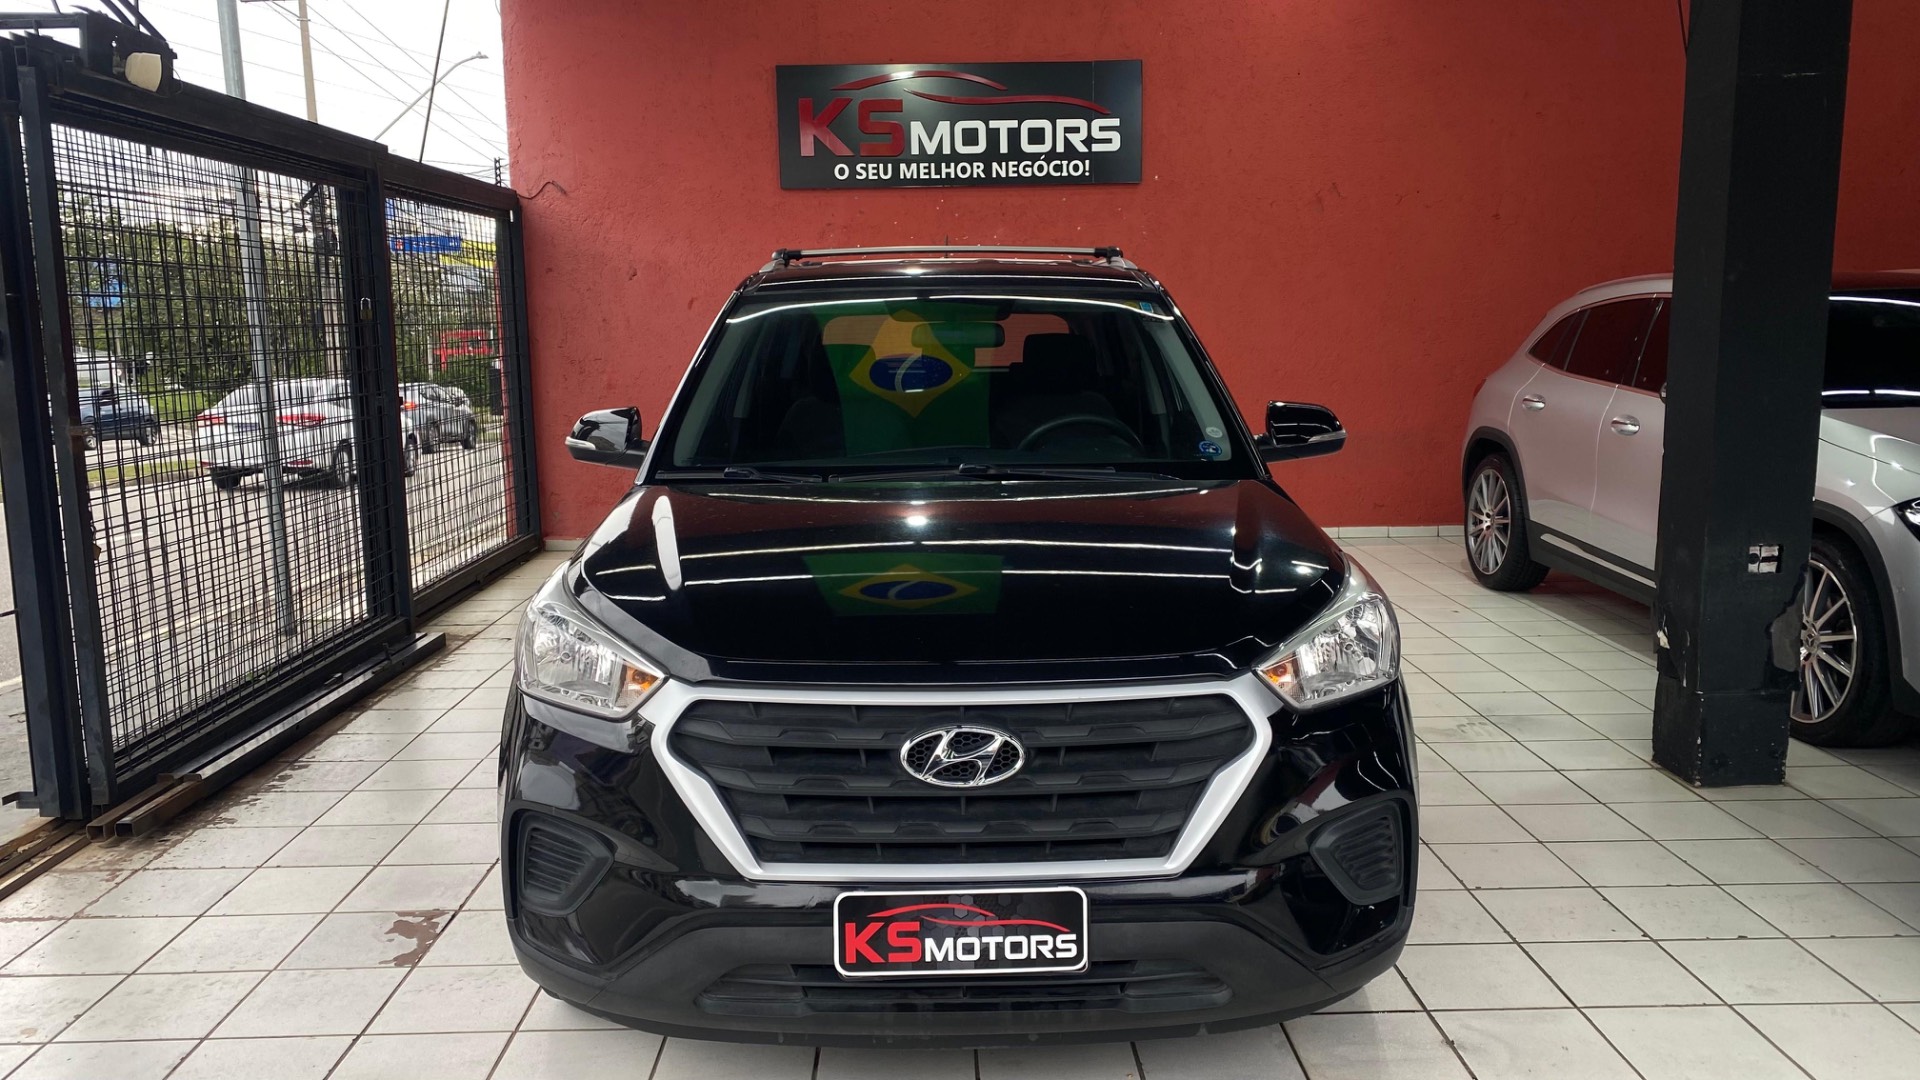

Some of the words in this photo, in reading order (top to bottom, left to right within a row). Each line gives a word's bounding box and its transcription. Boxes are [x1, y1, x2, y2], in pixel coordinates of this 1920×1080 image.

[798, 97, 905, 157] KS
[909, 118, 1121, 155] MOTORS
[834, 163, 849, 180] O
[855, 162, 893, 180] SEU
[899, 160, 985, 179] MELHOR
[992, 154, 1090, 178] NEGÓCIO!
[845, 921, 922, 964] KS
[924, 933, 1077, 962] MOTORS
